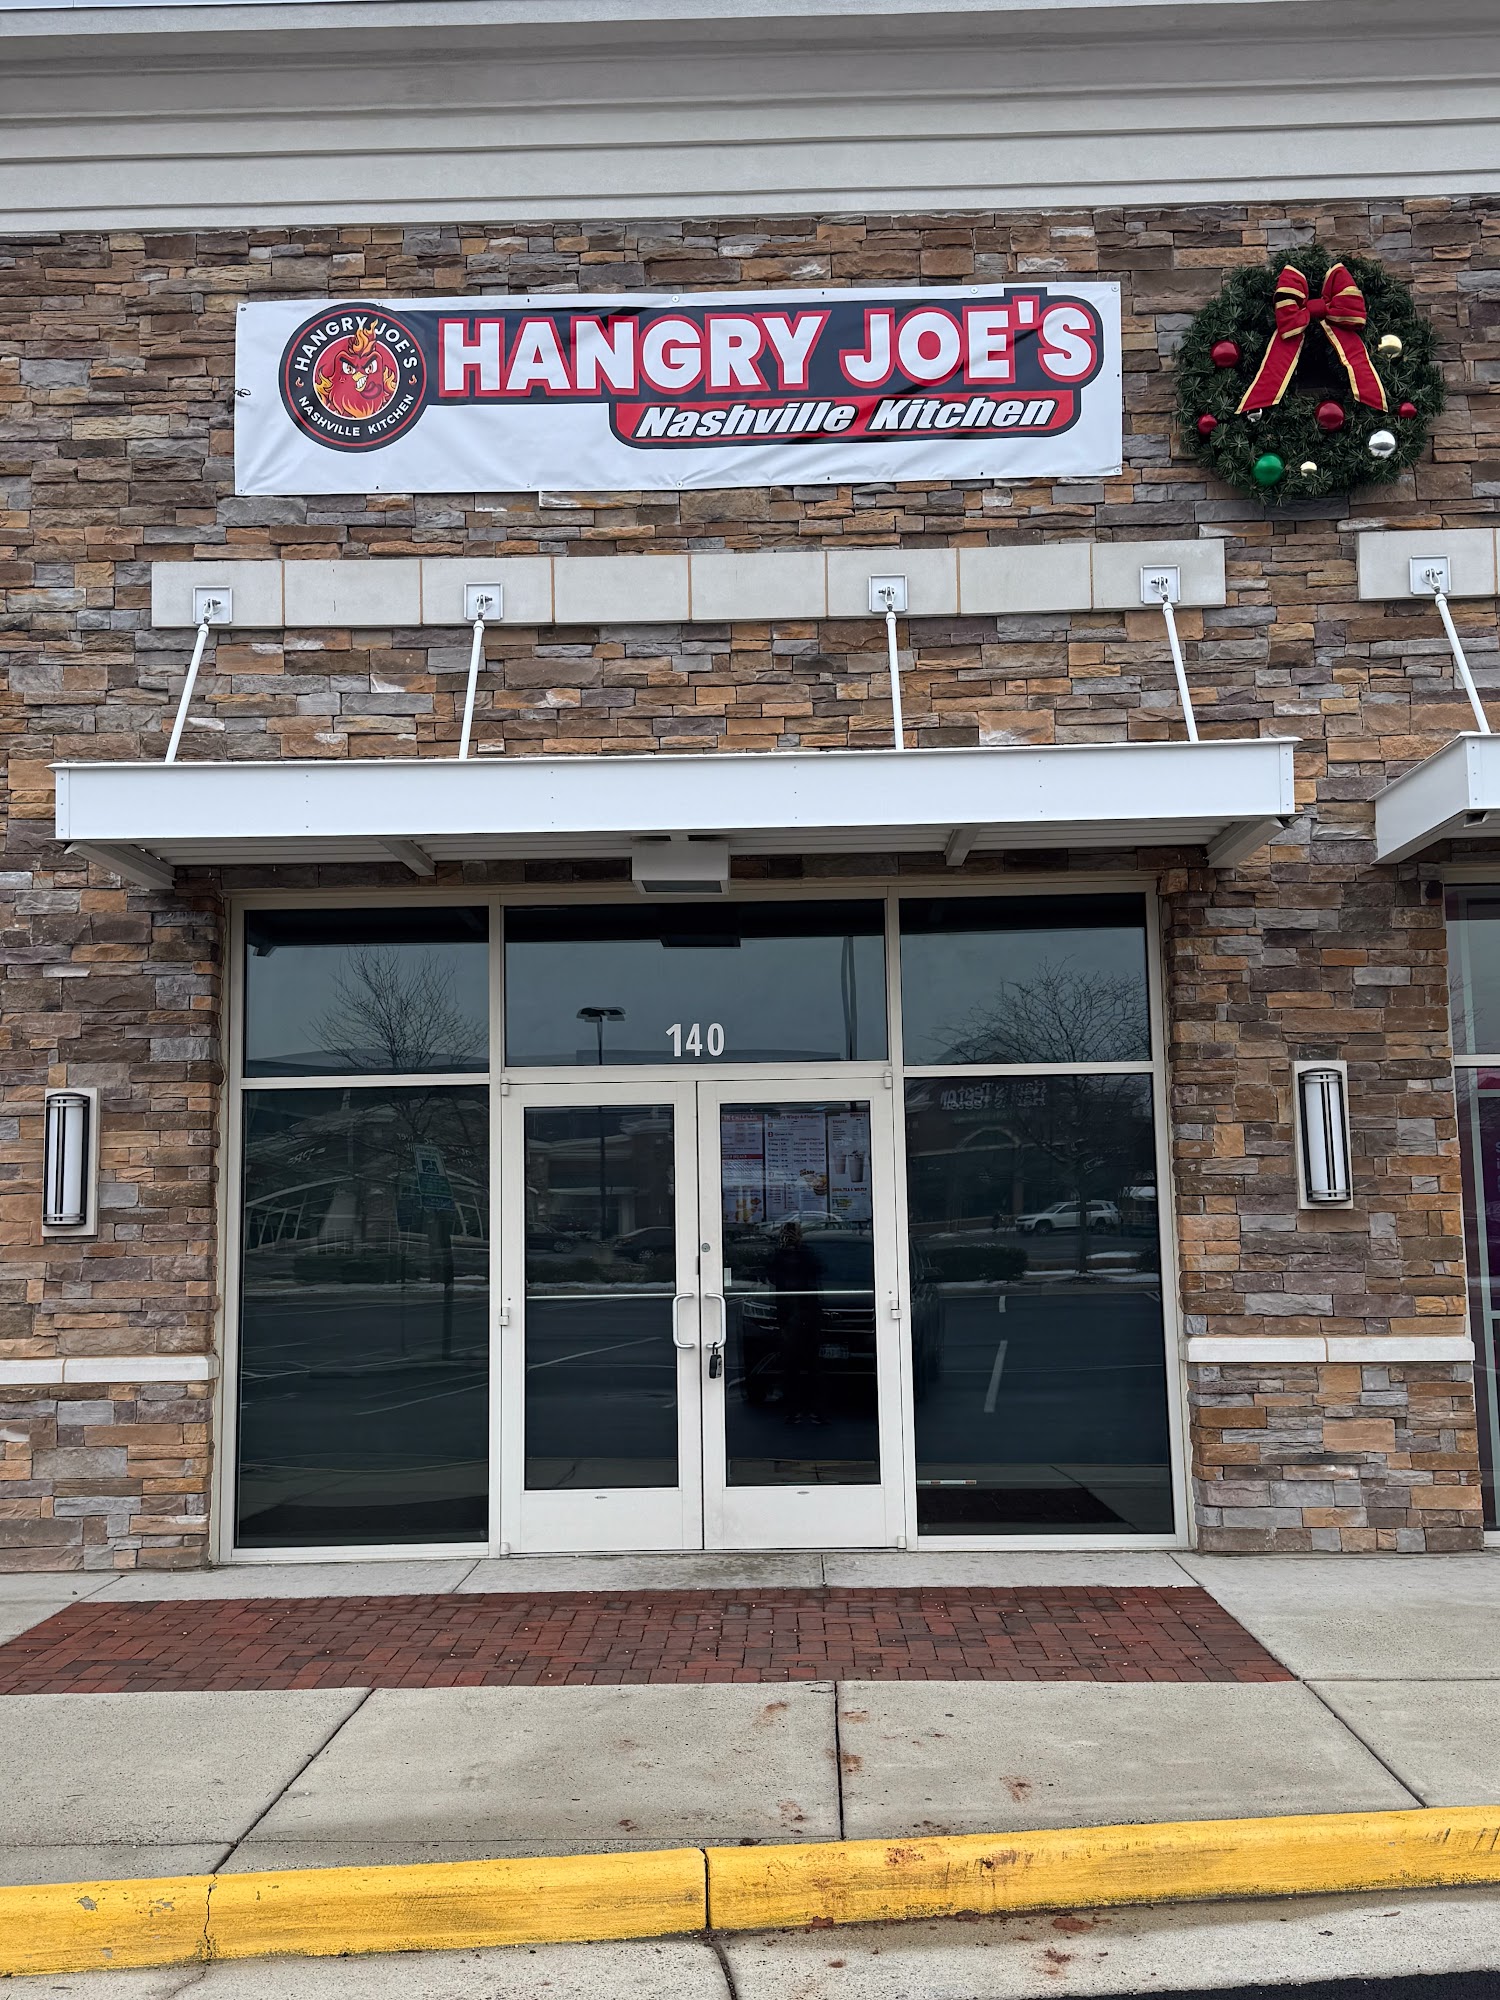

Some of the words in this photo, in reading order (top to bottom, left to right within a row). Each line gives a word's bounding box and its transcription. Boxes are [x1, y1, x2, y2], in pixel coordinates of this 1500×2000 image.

[295, 316, 368, 371] HANGRY
[374, 322, 418, 368] JOE'S
[440, 312, 829, 394] HANGRY
[841, 297, 1096, 387] JOE'S
[298, 396, 361, 437] NASHVILLE
[367, 394, 414, 434] KITCHEN
[635, 400, 857, 439] Nashville
[867, 396, 1057, 431] Kitchen
[665, 1022, 725, 1057] 140
